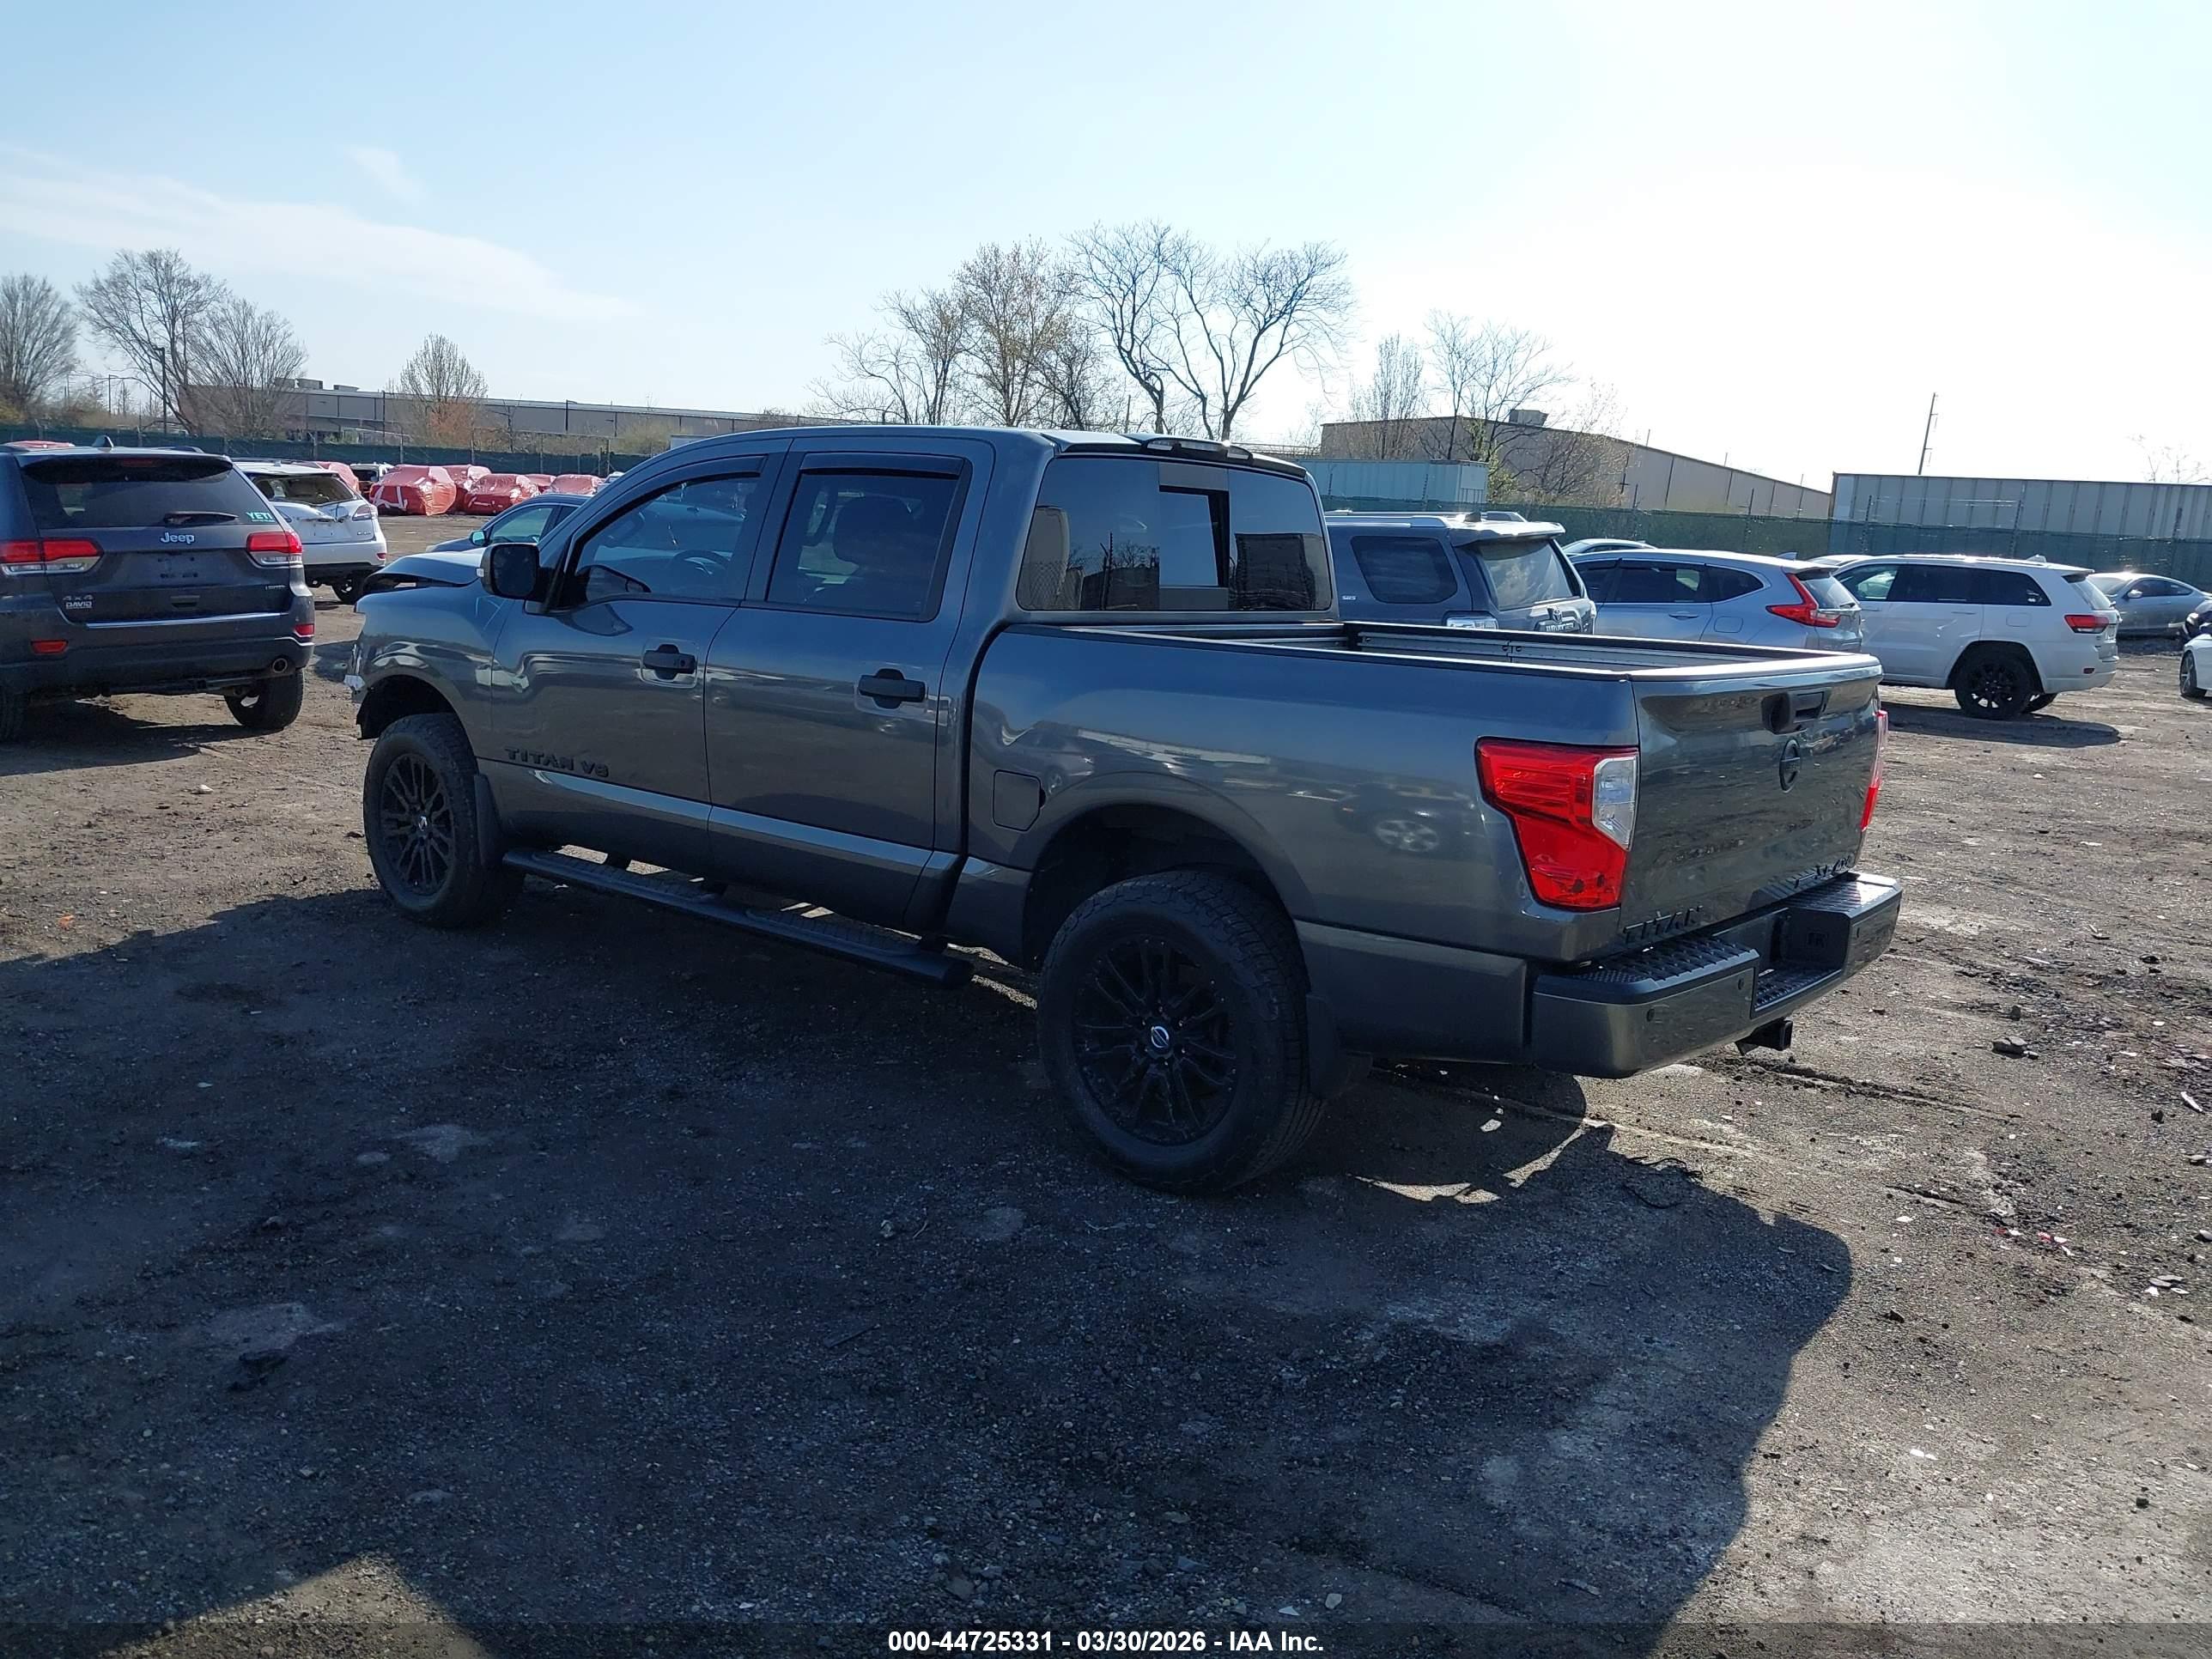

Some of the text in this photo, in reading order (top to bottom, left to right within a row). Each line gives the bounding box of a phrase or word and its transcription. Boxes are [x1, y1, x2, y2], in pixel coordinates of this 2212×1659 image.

[160, 532, 195, 544] Jeep
[505, 746, 610, 778] TITAN V8
